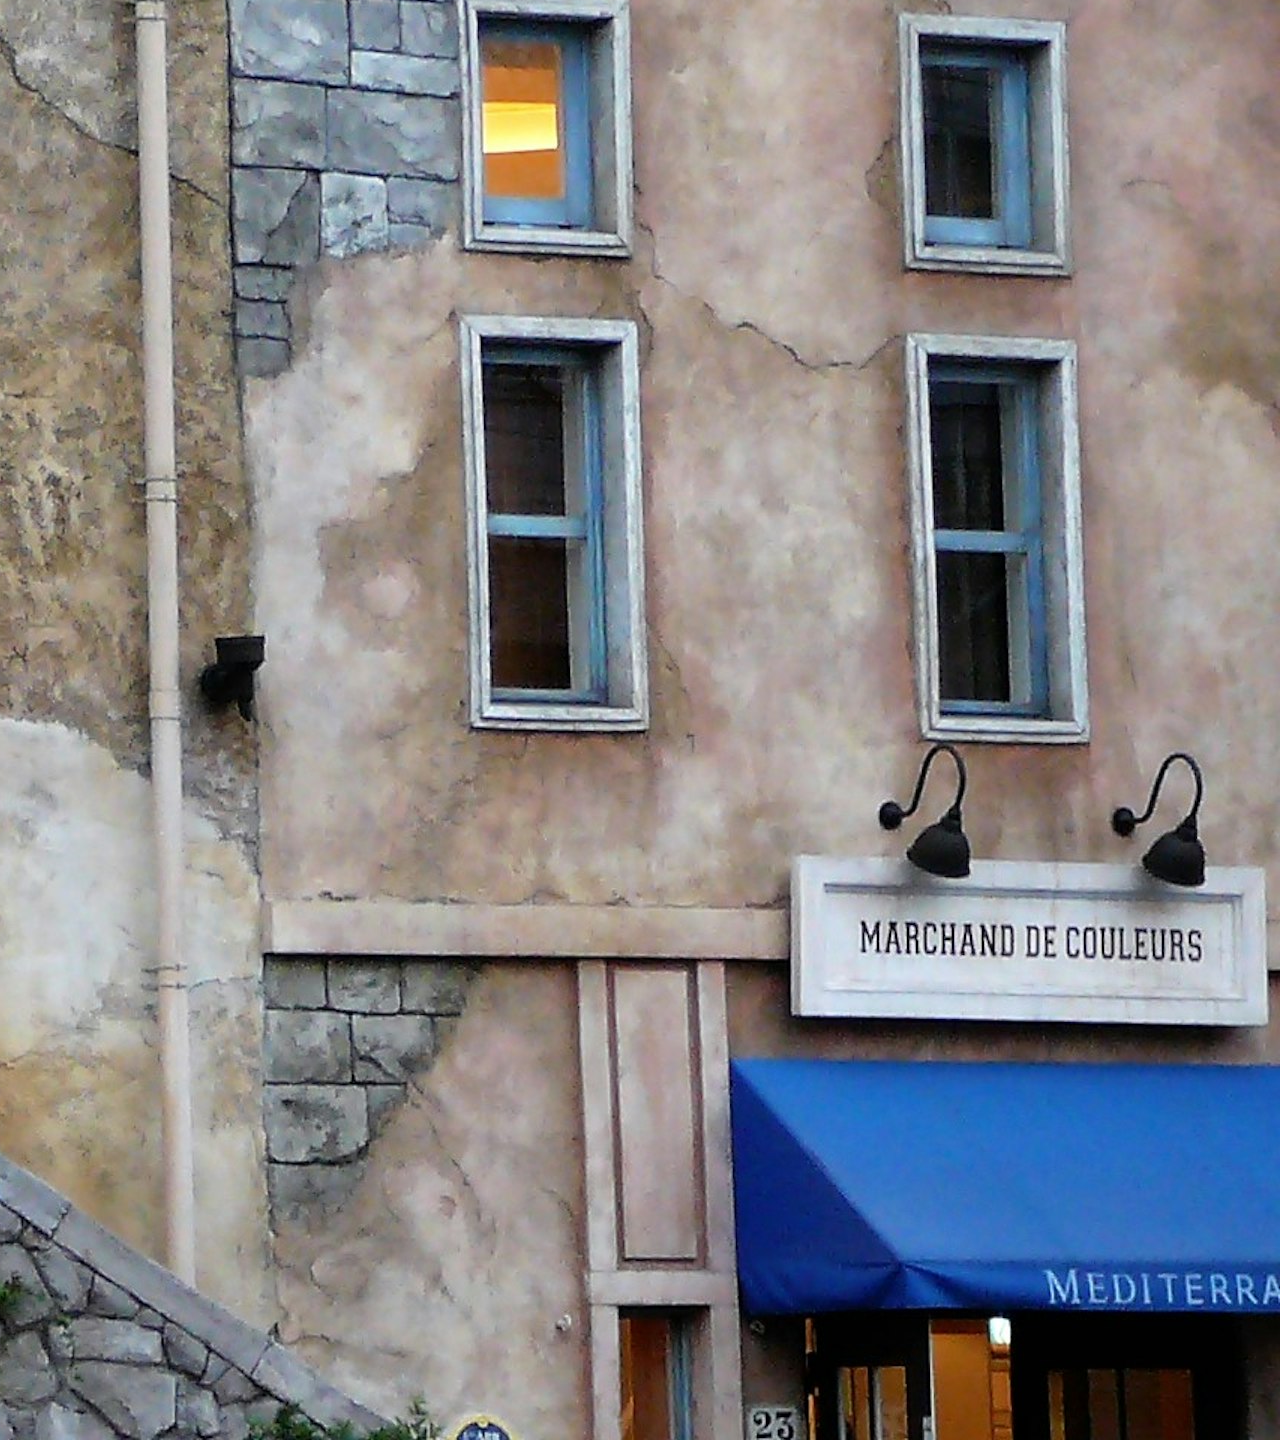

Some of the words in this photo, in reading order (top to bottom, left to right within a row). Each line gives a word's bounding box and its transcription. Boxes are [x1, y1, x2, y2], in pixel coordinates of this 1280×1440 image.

[859, 919, 1016, 958] MARCHAND
[1025, 924, 1058, 958] DE
[1065, 925, 1204, 963] COULEURS
[752, 1411, 795, 1440] 23
